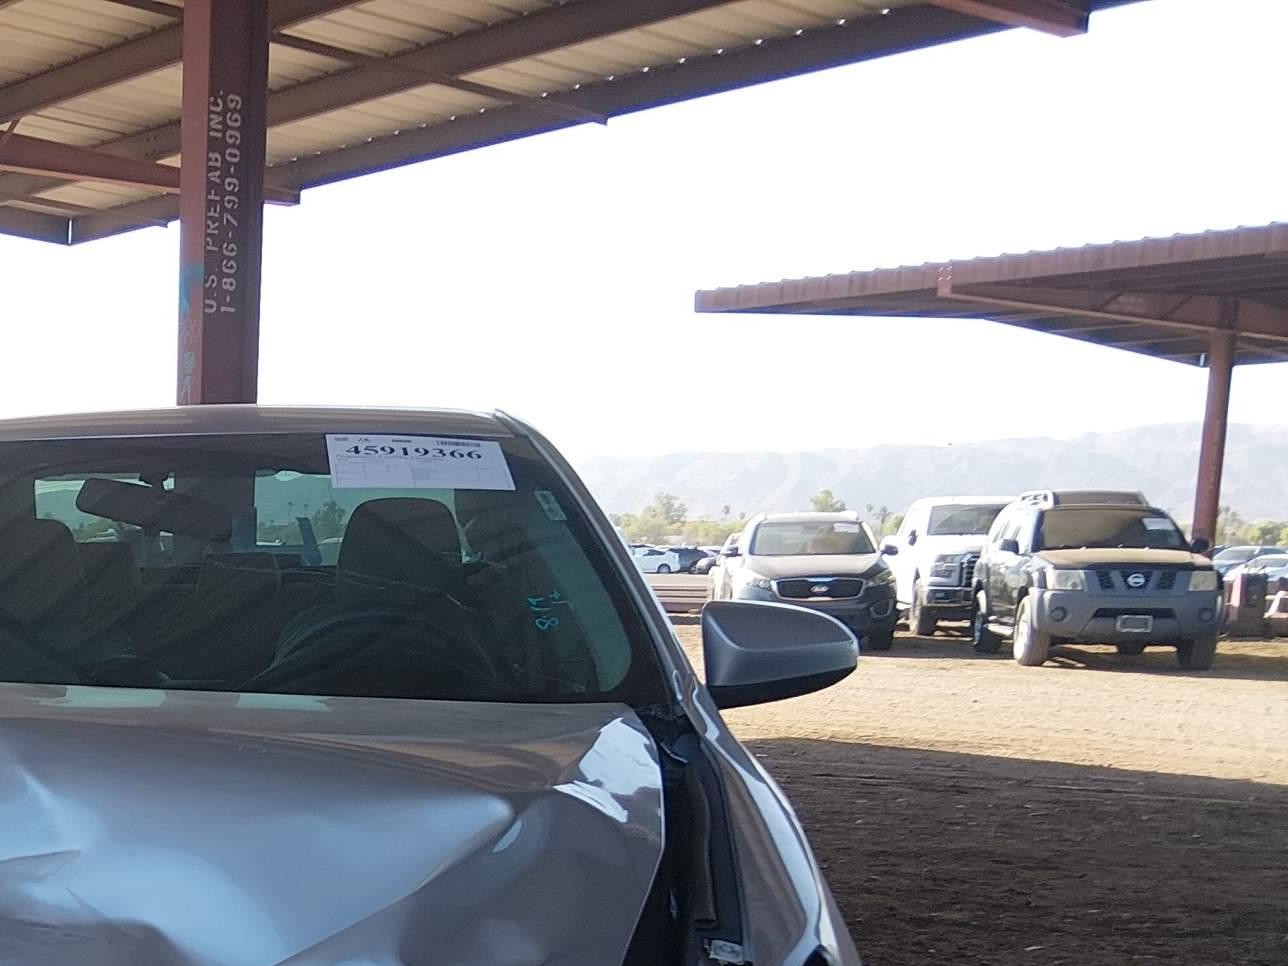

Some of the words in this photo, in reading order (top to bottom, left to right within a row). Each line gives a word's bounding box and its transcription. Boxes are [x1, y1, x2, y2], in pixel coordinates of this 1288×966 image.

[206, 152, 222, 251] PREFAB
[221, 94, 242, 313] 1-866-799-0969
[346, 445, 482, 459] 45919366
